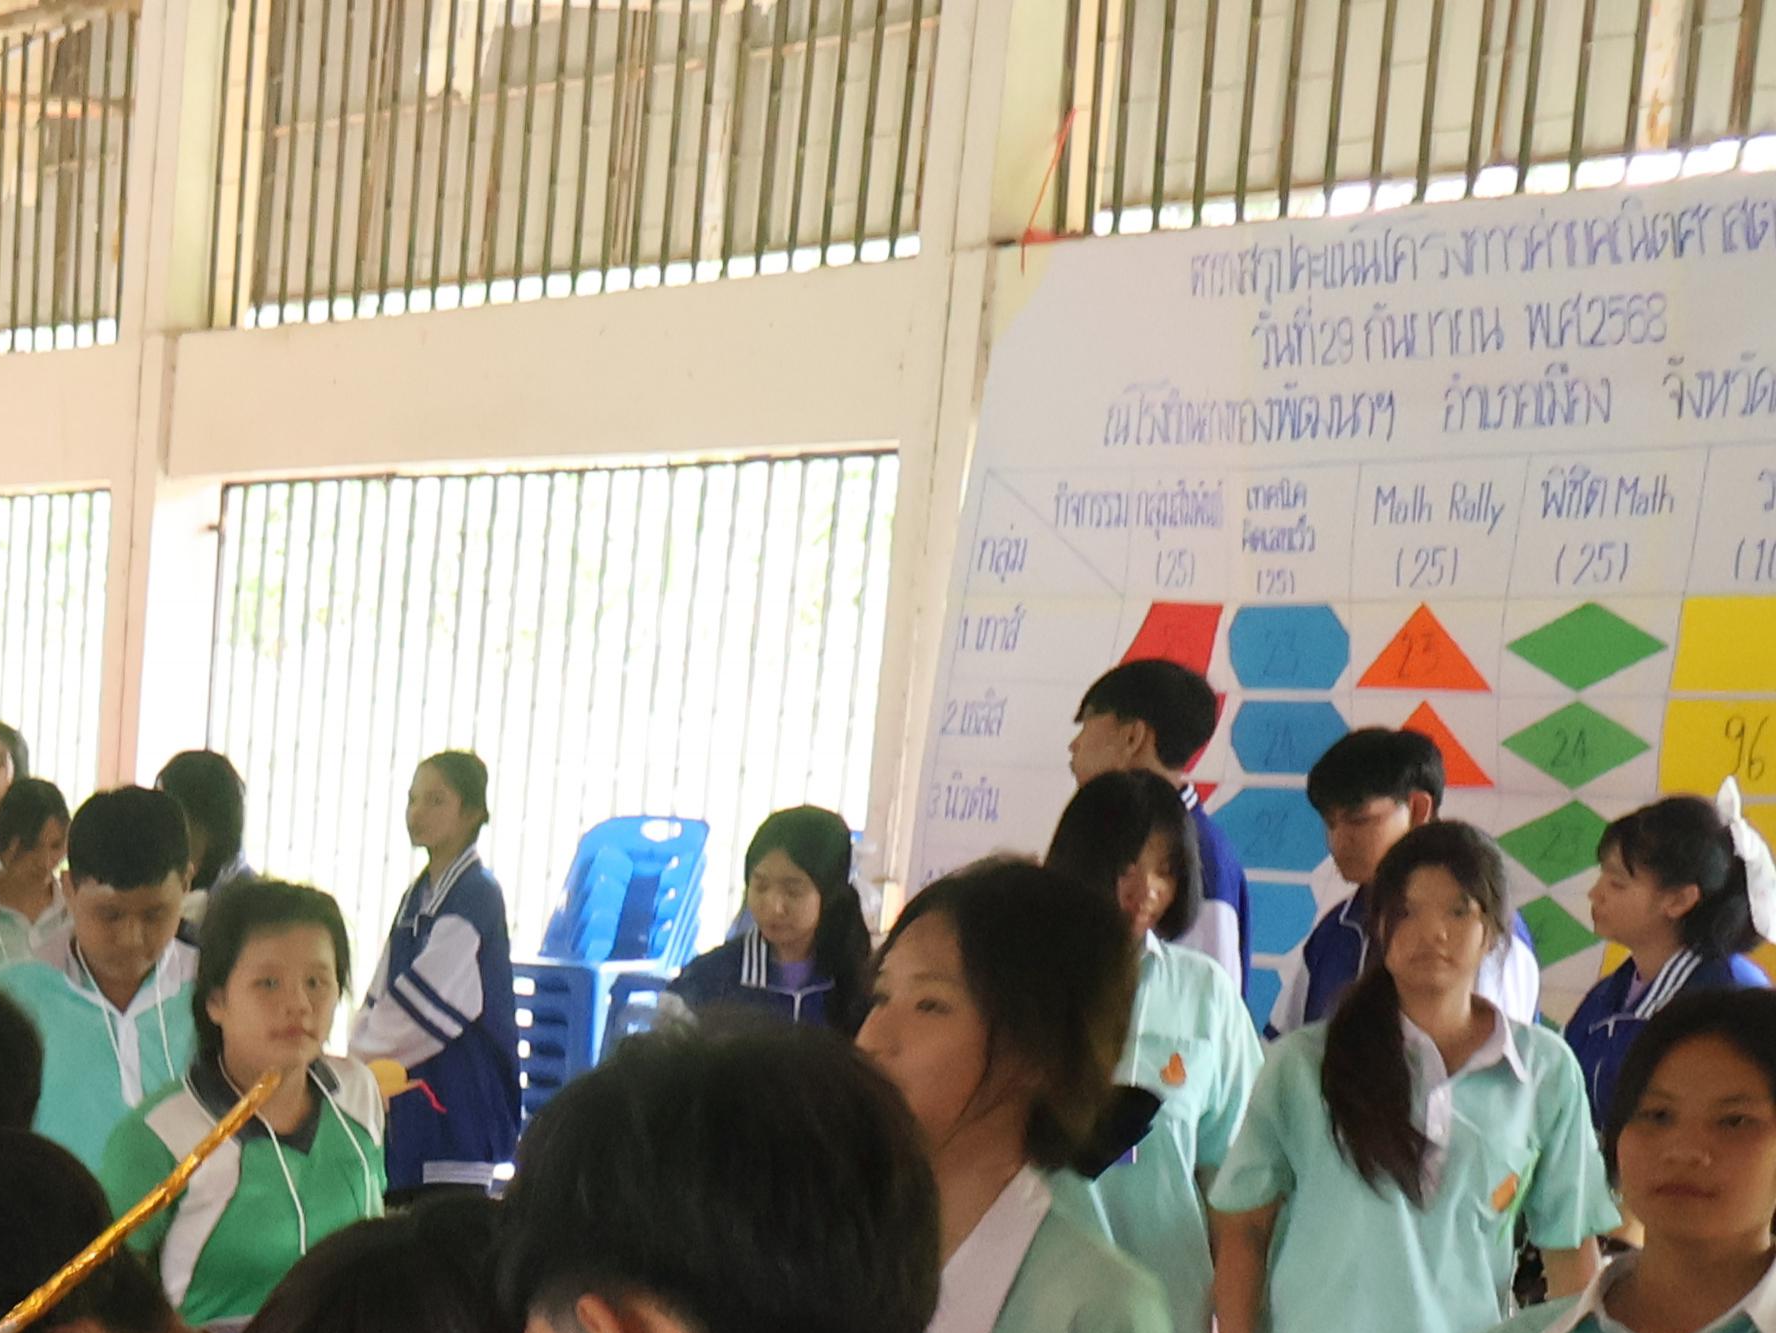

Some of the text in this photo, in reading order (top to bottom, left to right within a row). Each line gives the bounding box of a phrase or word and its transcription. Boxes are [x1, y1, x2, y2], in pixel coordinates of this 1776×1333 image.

[1373, 481, 1505, 535] Math Rally
[1614, 473, 1674, 518] Math
[978, 524, 1028, 584] กลุ่ม
[1154, 549, 1196, 589] (25)
[1394, 545, 1459, 588] (25)
[1554, 541, 1629, 587] (25)
[1256, 568, 1296, 597] (25)
[1725, 714, 1769, 781] 96
